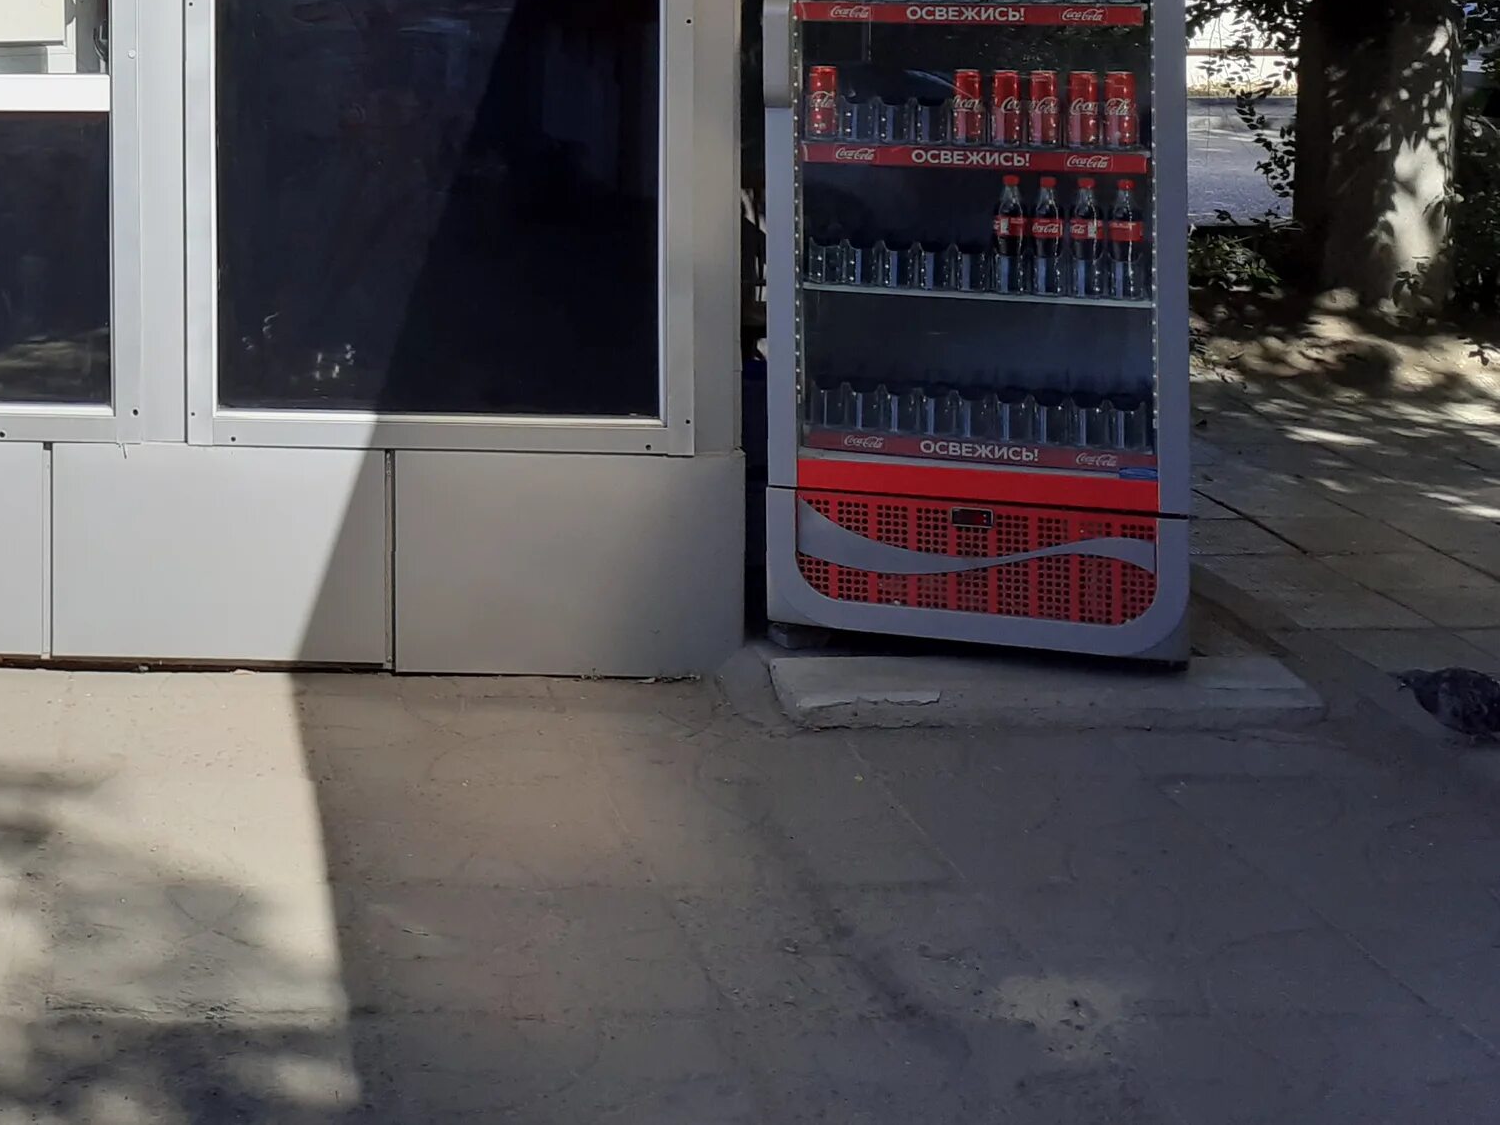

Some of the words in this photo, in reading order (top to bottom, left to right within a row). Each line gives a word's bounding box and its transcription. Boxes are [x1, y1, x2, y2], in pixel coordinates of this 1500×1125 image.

[906, 6, 1026, 22] ОСВЕЖИСЬ!
[911, 150, 1031, 167] ОСВЕЖИСЬ!
[919, 439, 1040, 462] ОСВЕЖИСЬ!
